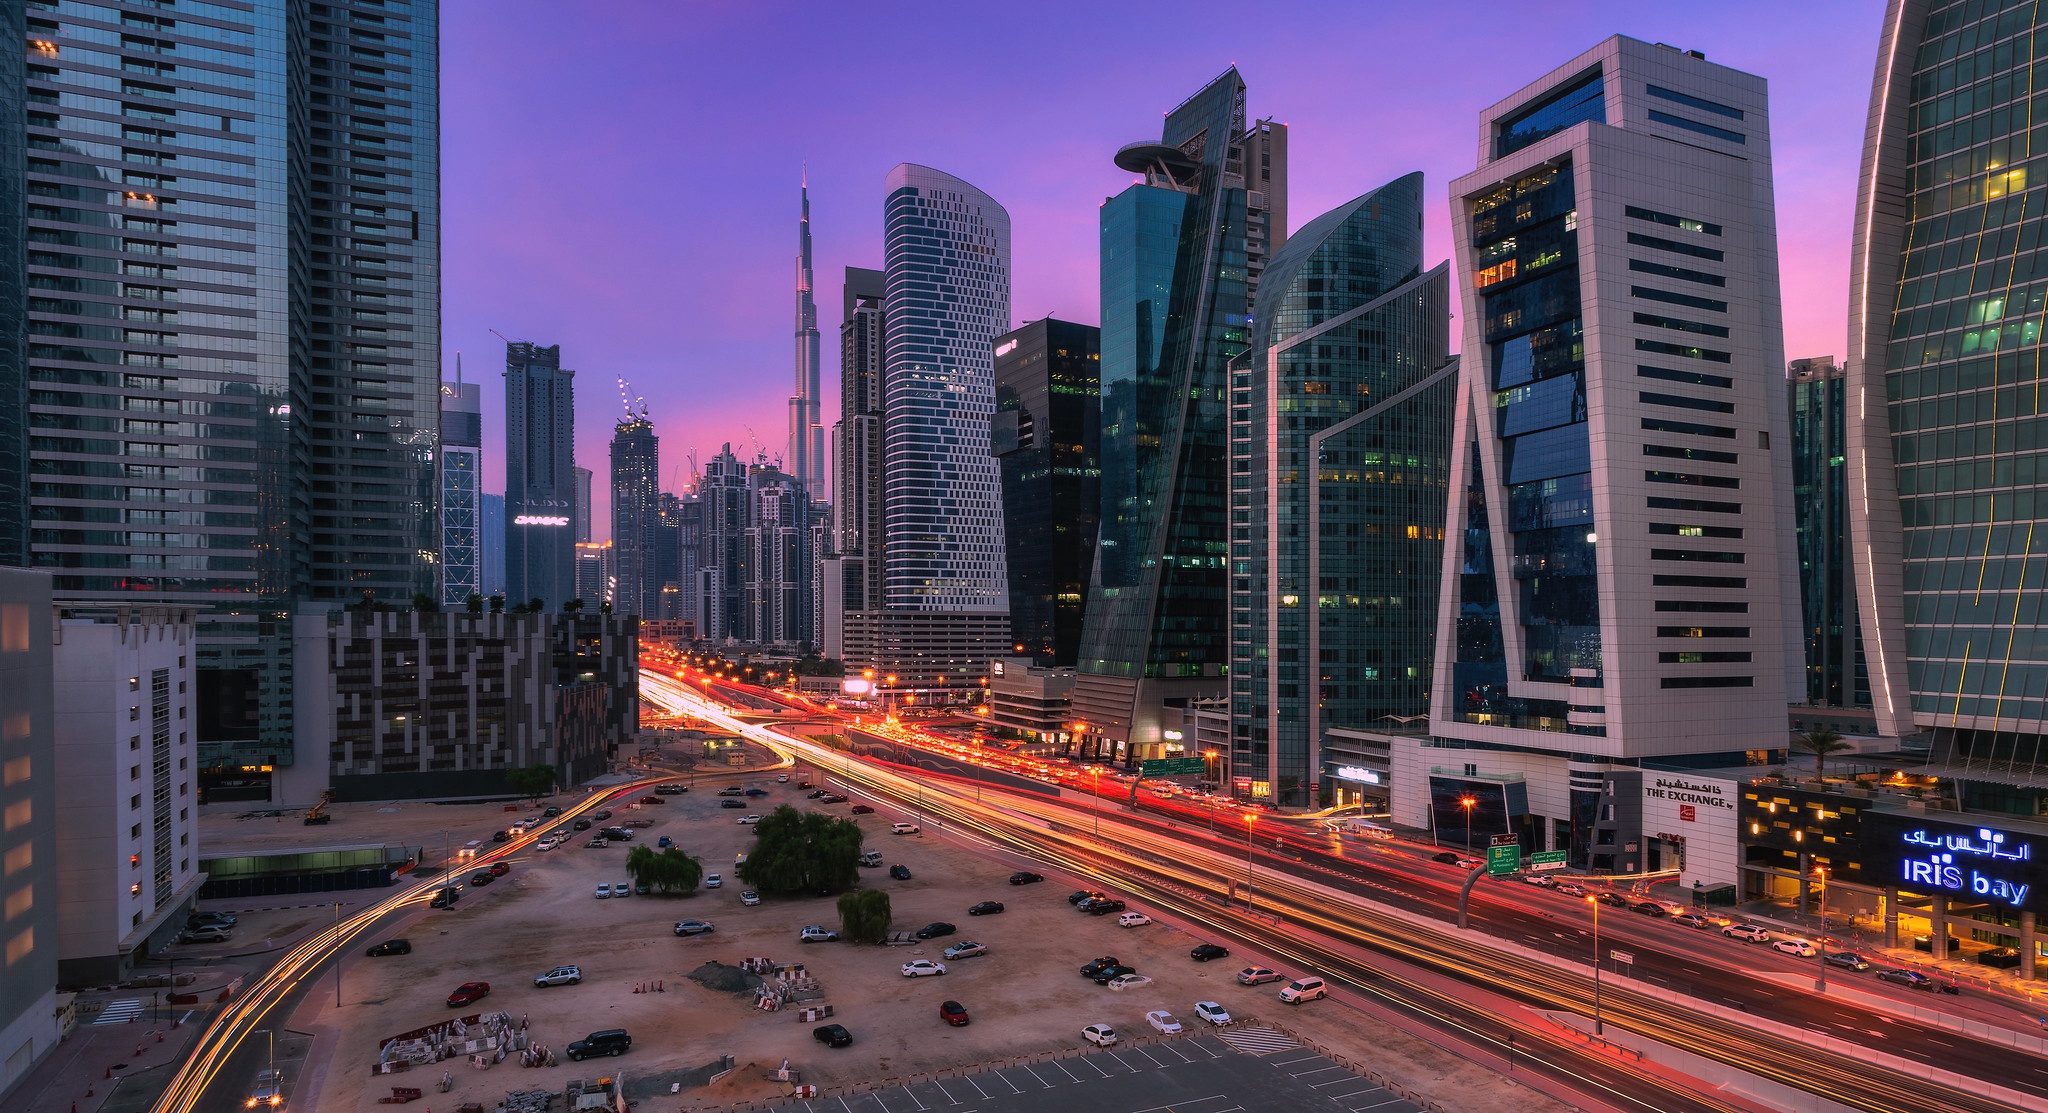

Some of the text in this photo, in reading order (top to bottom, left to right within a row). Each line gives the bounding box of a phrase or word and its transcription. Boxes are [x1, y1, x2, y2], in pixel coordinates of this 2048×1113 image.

[1645, 787, 1665, 798] THE
[1668, 791, 1725, 807] EXCHANGE
[1973, 870, 2029, 906] bay
